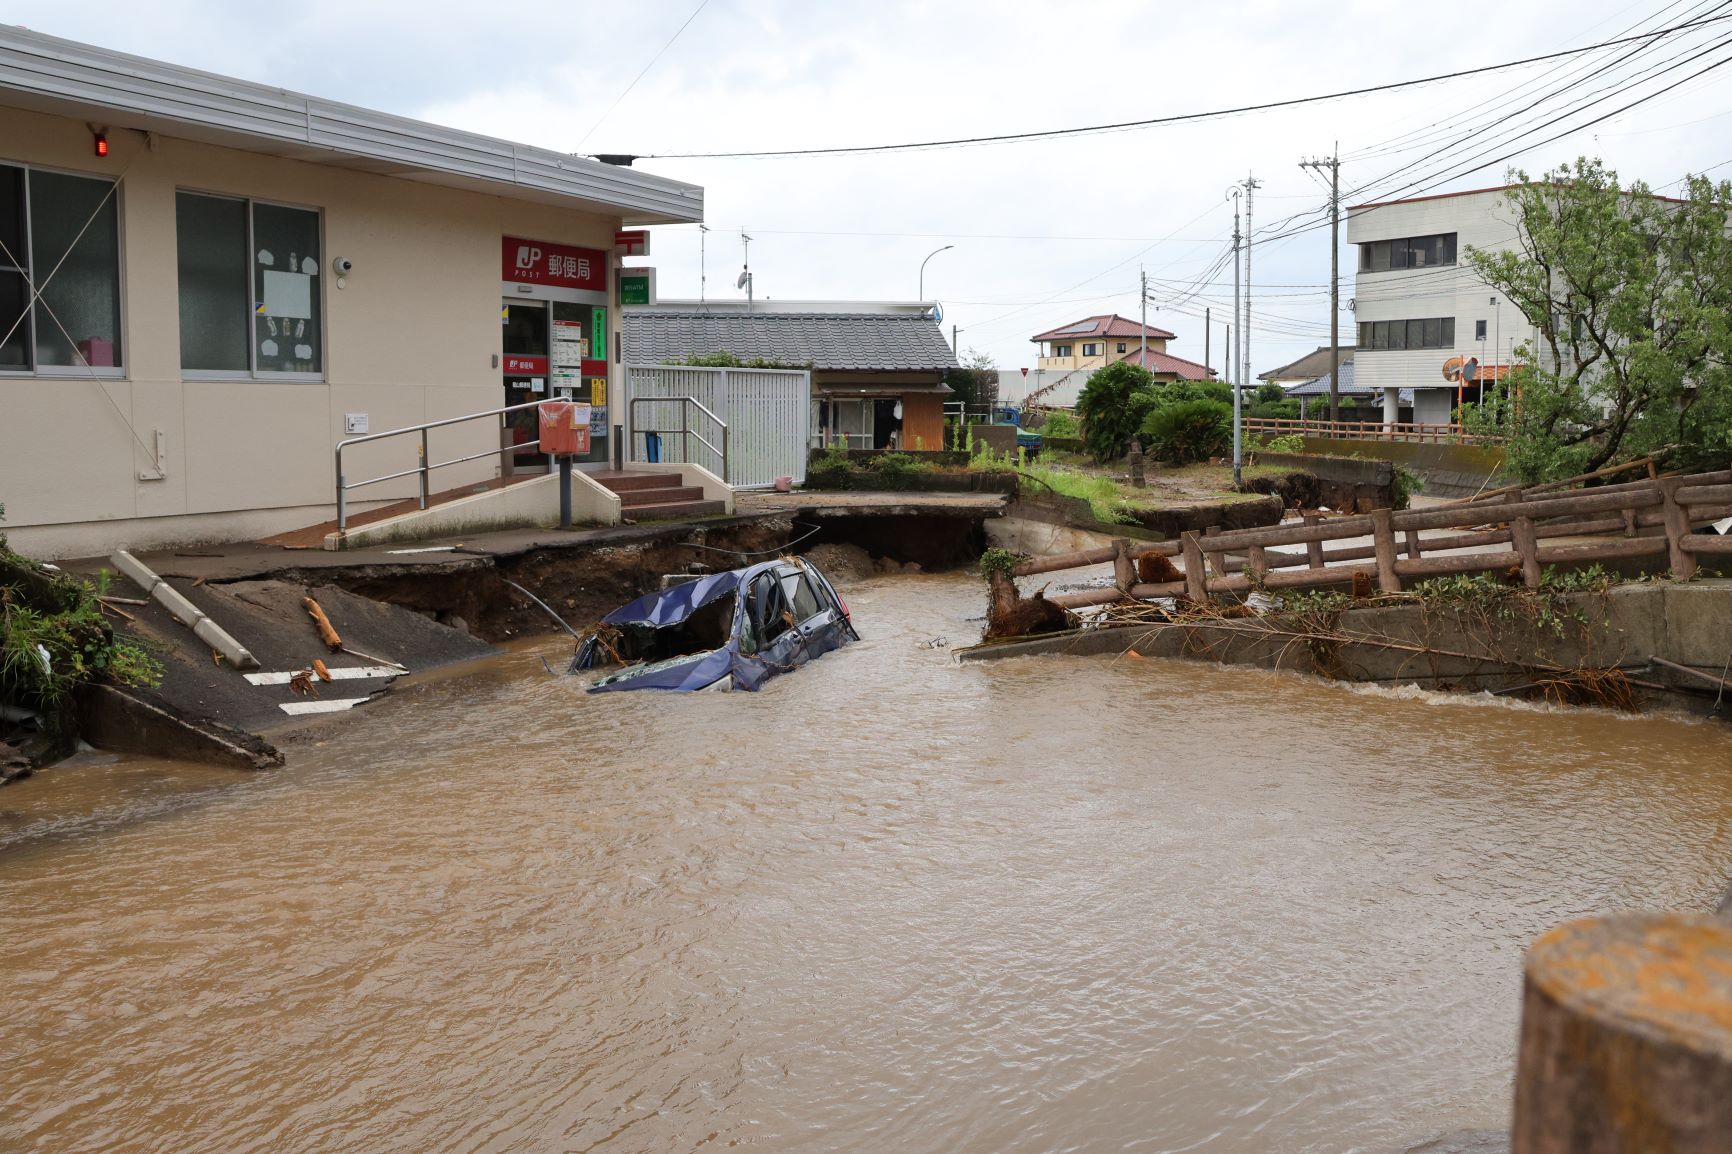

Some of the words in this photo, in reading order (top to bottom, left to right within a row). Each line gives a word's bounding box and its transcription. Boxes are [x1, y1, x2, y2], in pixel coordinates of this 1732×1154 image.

[514, 269, 540, 279] POST
[516, 246, 542, 269] JP
[548, 254, 591, 281] 郵便局
